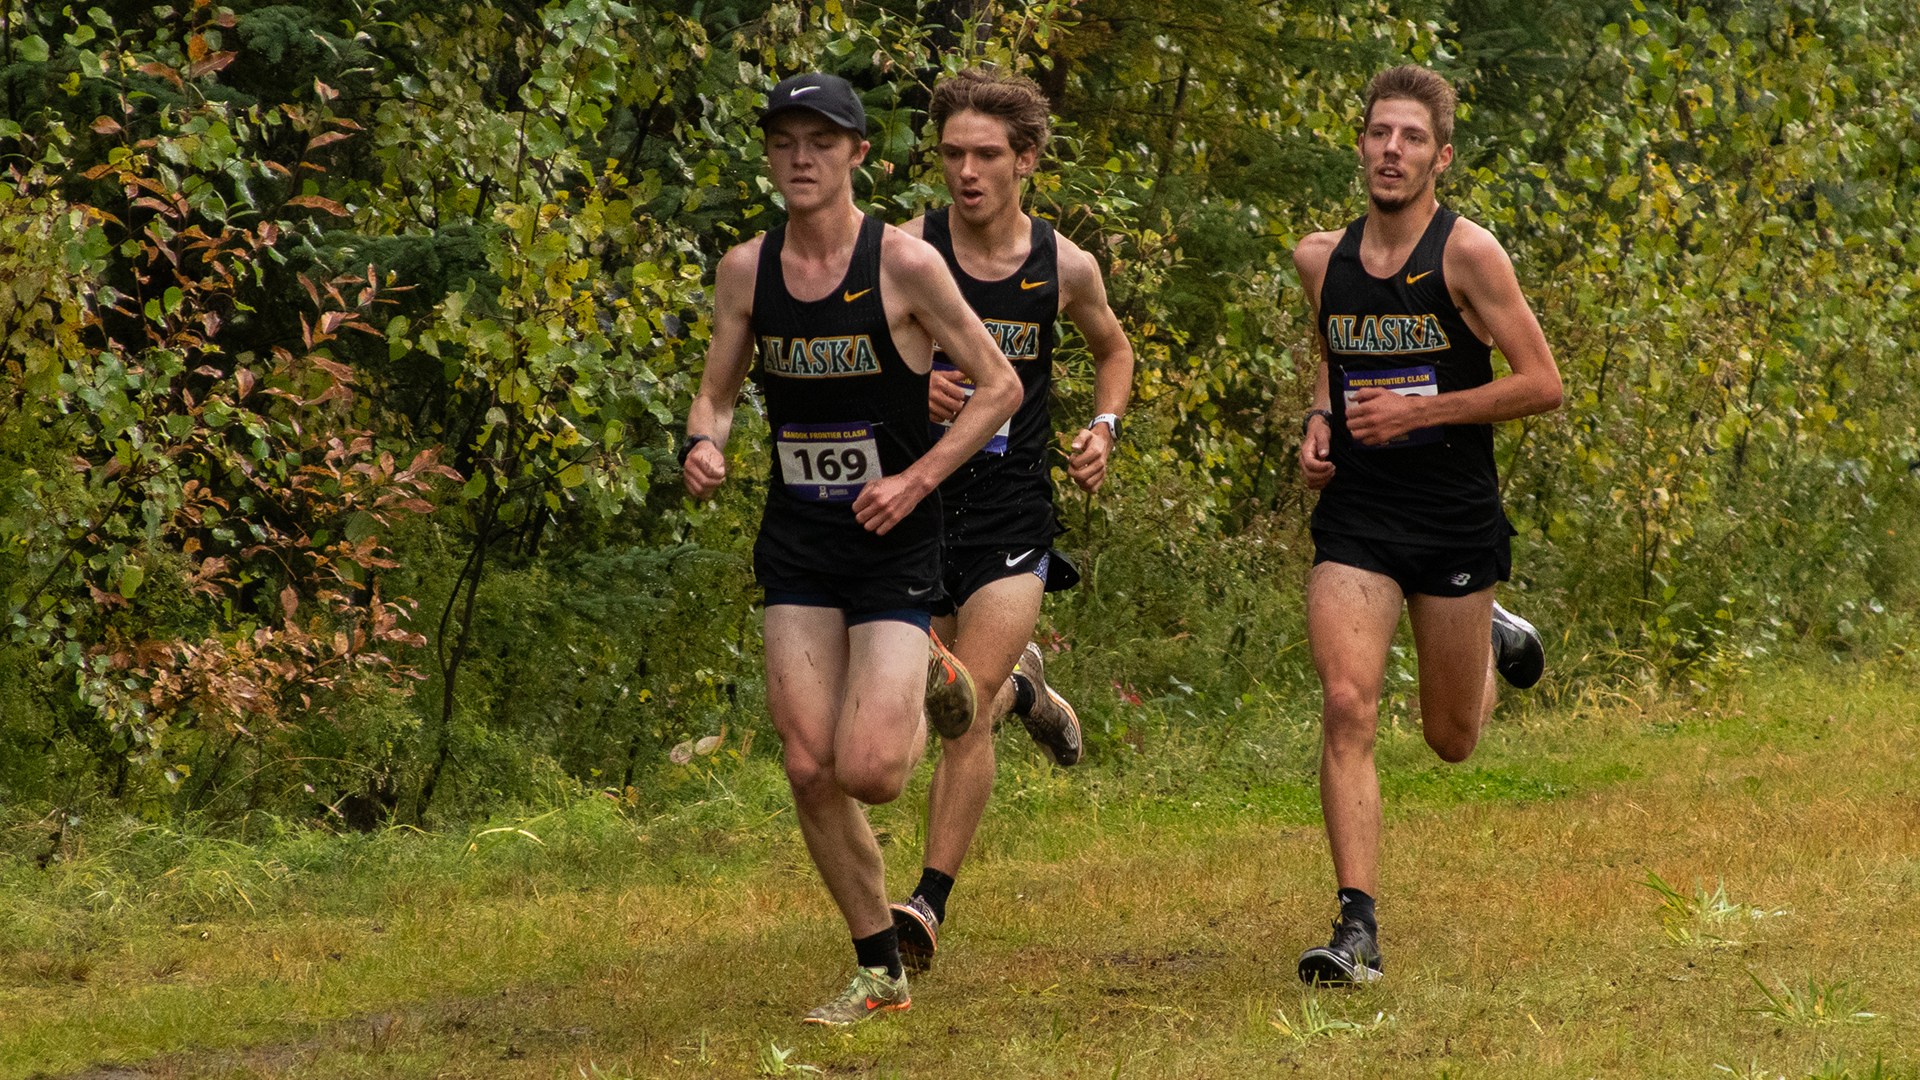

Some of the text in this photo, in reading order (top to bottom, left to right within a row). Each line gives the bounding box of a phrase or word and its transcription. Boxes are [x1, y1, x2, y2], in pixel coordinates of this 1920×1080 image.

[1327, 314, 1451, 355] ALASKA
[1349, 374, 1430, 387] NANOOK FRONTIER CLASH
[809, 431, 842, 439] FRONTIER
[843, 429, 867, 439] CLASH
[793, 448, 868, 482] 169
